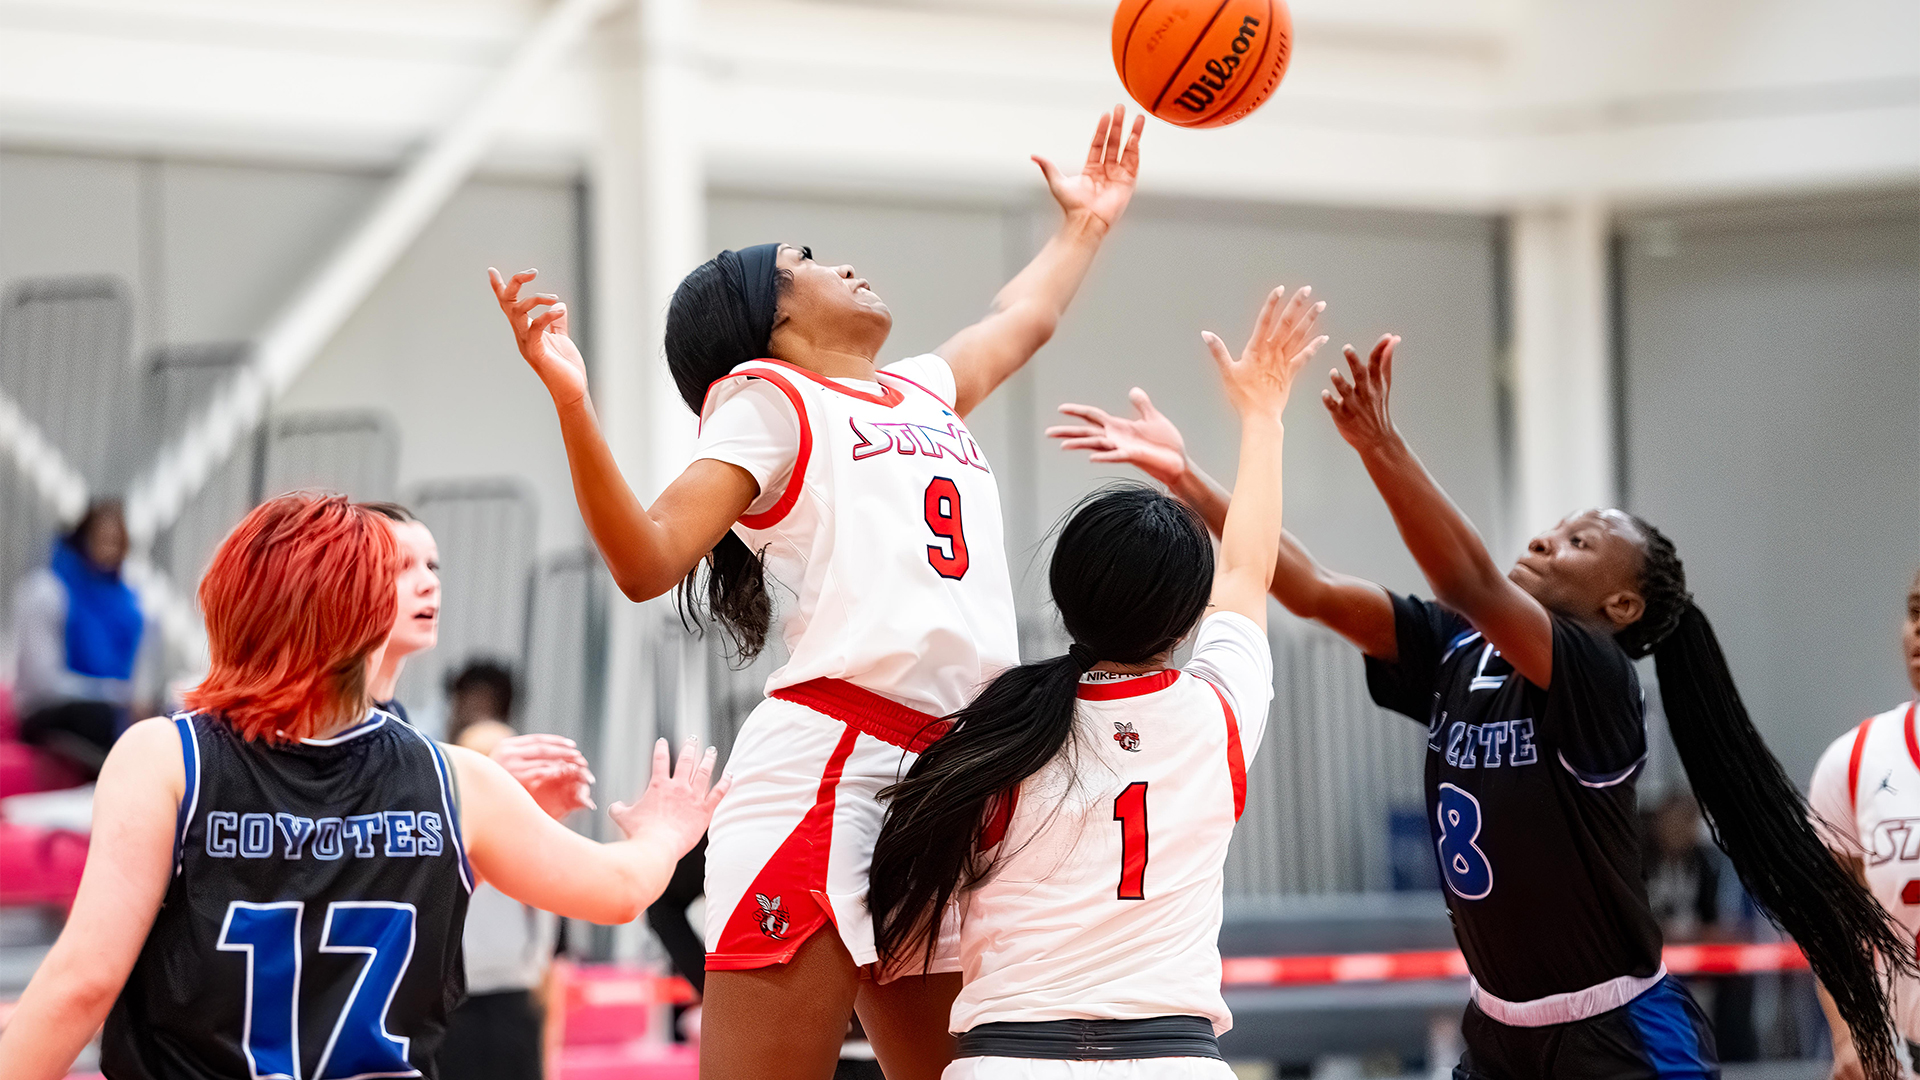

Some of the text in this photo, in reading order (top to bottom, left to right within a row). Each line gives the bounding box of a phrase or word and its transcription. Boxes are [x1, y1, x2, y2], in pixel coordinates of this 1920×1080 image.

[1174, 15, 1260, 114] Wilson
[924, 475, 970, 581] 9
[206, 810, 444, 861] COYOTES
[1113, 781, 1149, 901] 1
[1437, 782, 1494, 900] 8
[216, 900, 423, 1080] 12
